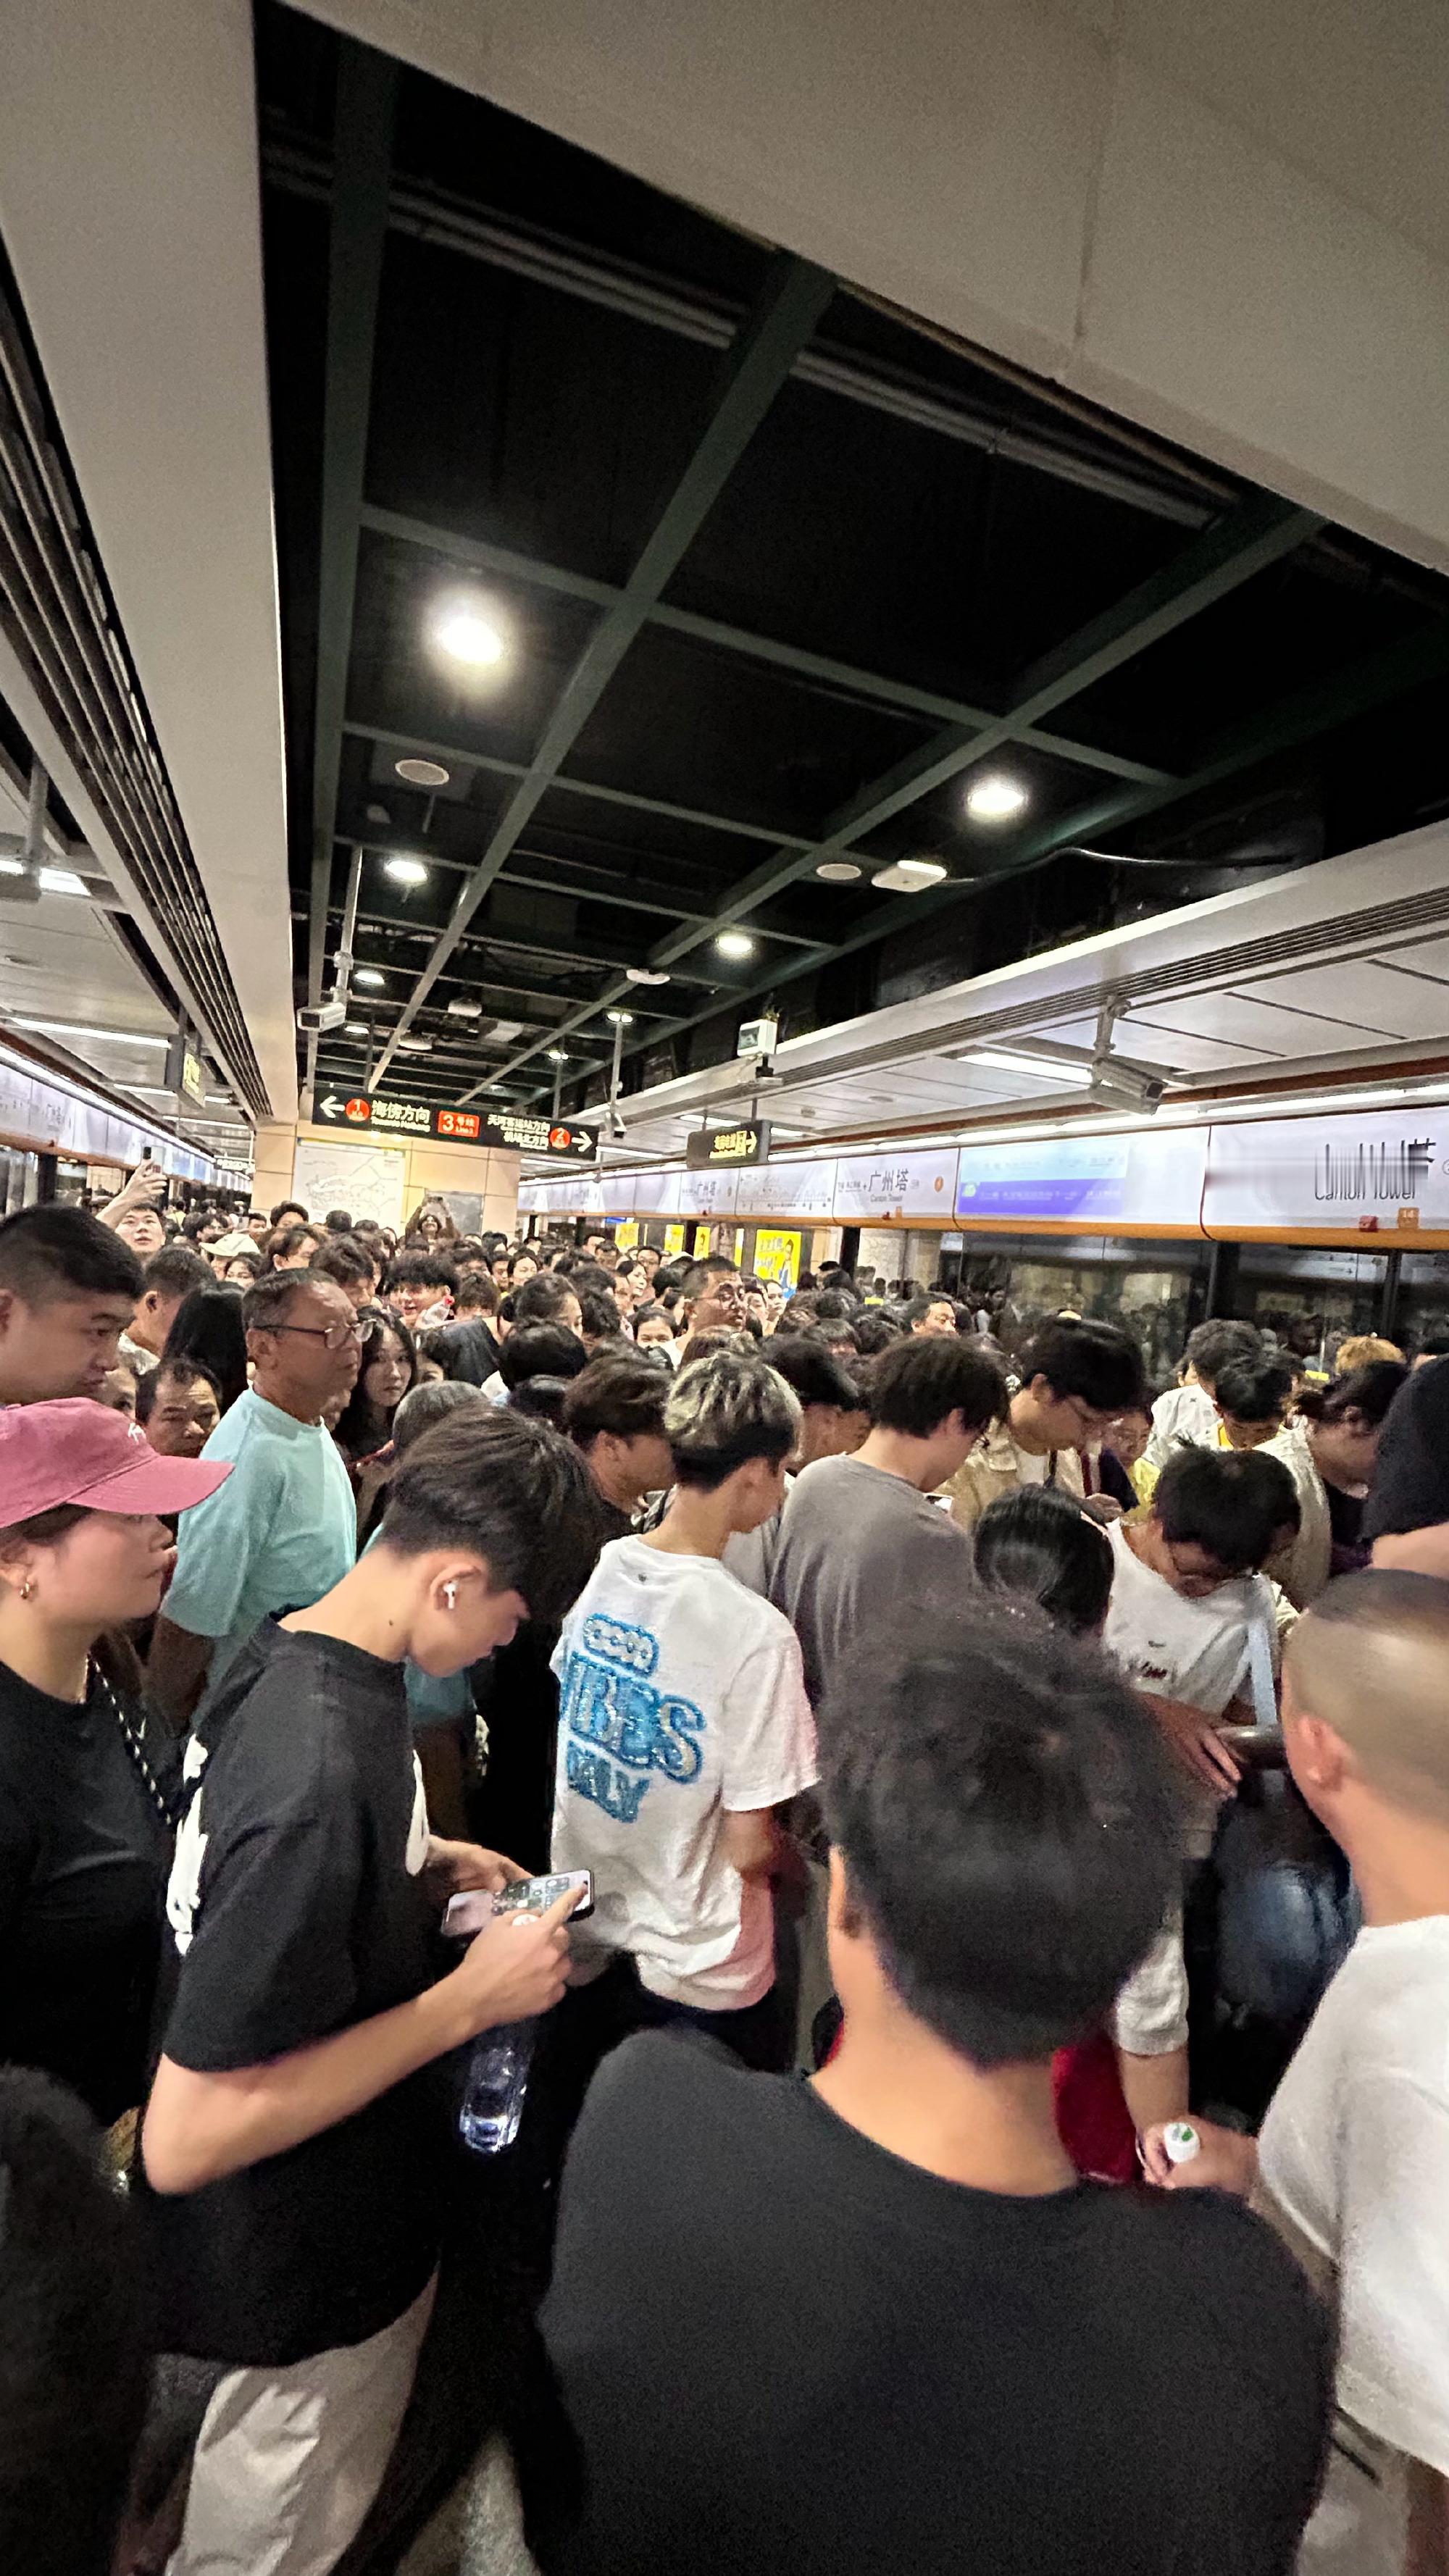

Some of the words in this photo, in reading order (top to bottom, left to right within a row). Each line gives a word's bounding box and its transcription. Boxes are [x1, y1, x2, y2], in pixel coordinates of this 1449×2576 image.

[354, 1098, 361, 1111] 1
[371, 1100, 430, 1124] 海傍方向
[868, 1168, 909, 1192] 广州塔
